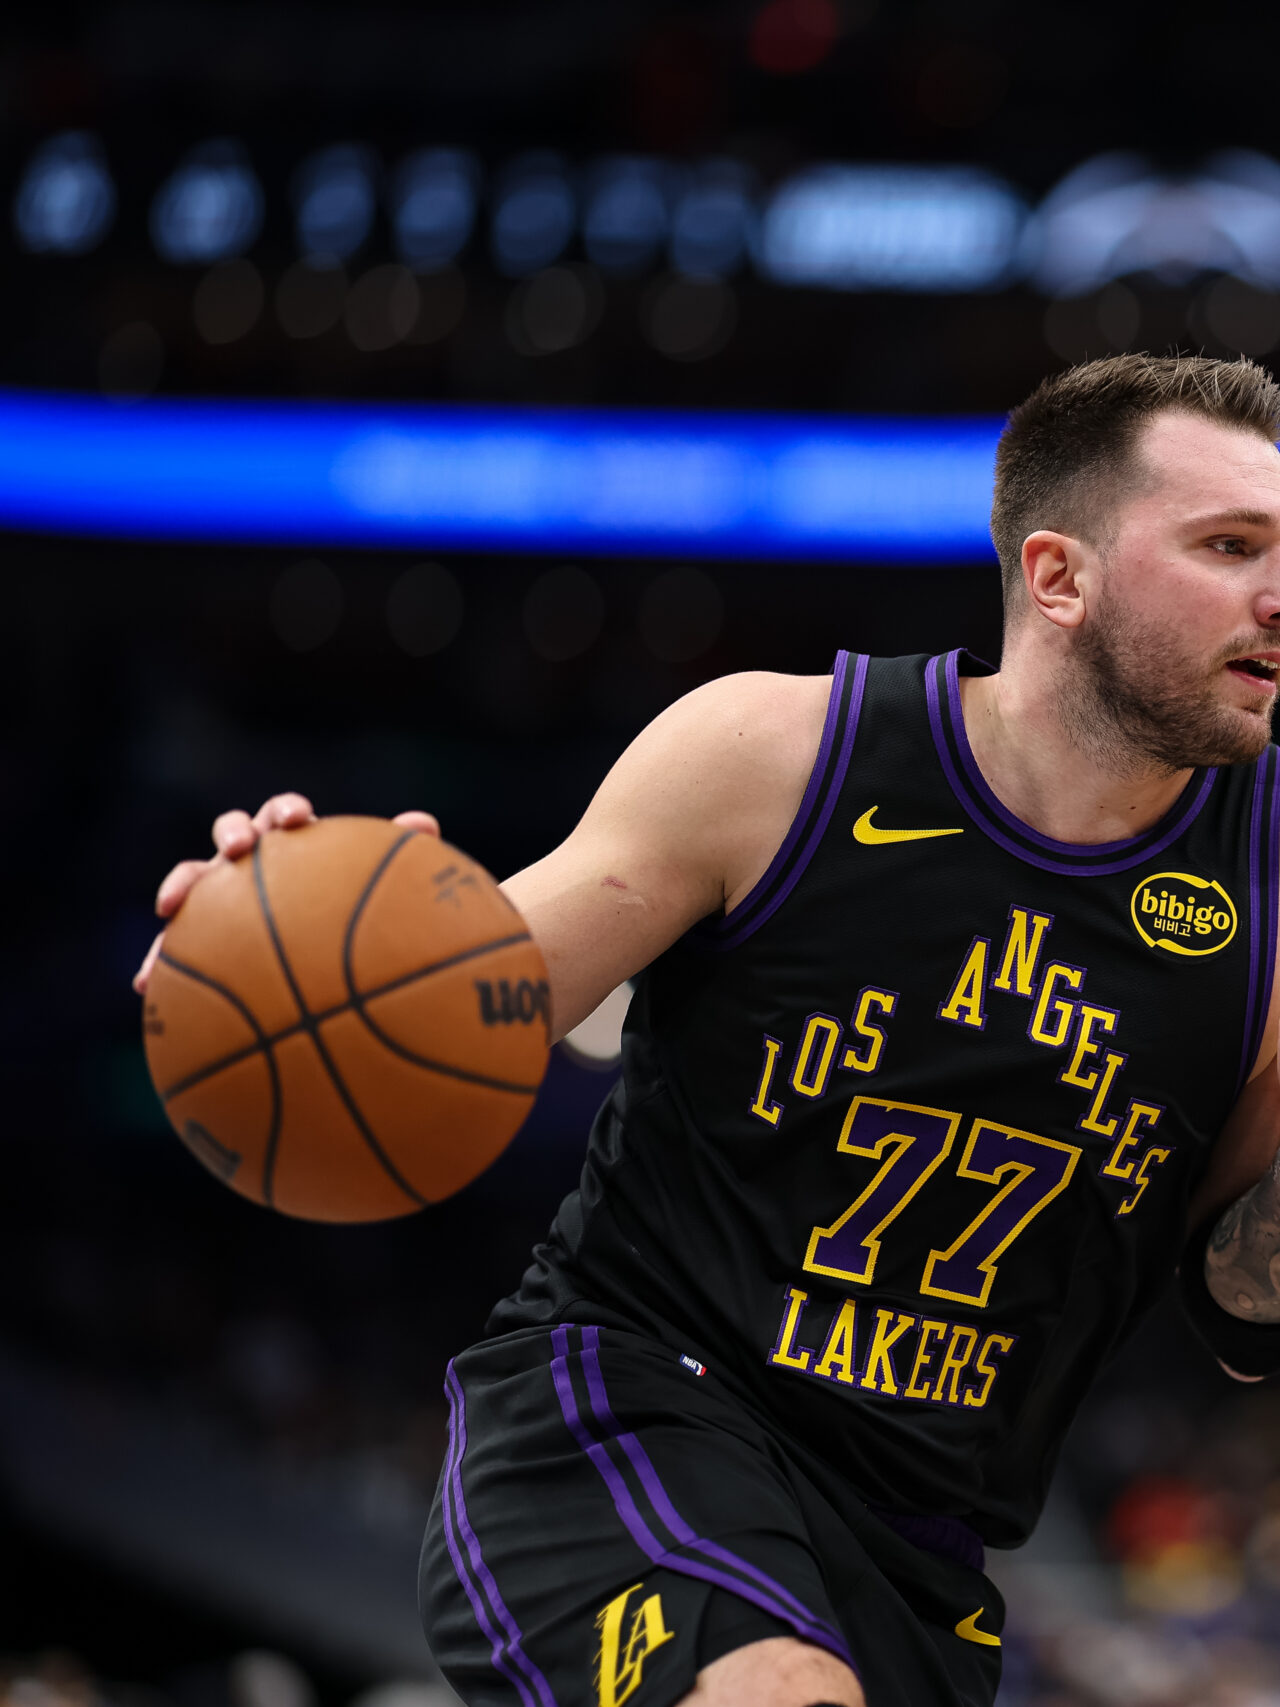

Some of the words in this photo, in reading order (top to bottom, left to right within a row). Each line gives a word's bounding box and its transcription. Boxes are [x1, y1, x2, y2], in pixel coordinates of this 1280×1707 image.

[1140, 888, 1231, 935] bibigo
[1153, 917, 1191, 937] 비비고
[750, 985, 899, 1129] LOS
[938, 904, 1176, 1219] ANGELES
[802, 1095, 1083, 1308] 77
[682, 1355, 697, 1370] NBA
[768, 1285, 1018, 1409] LAKERS
